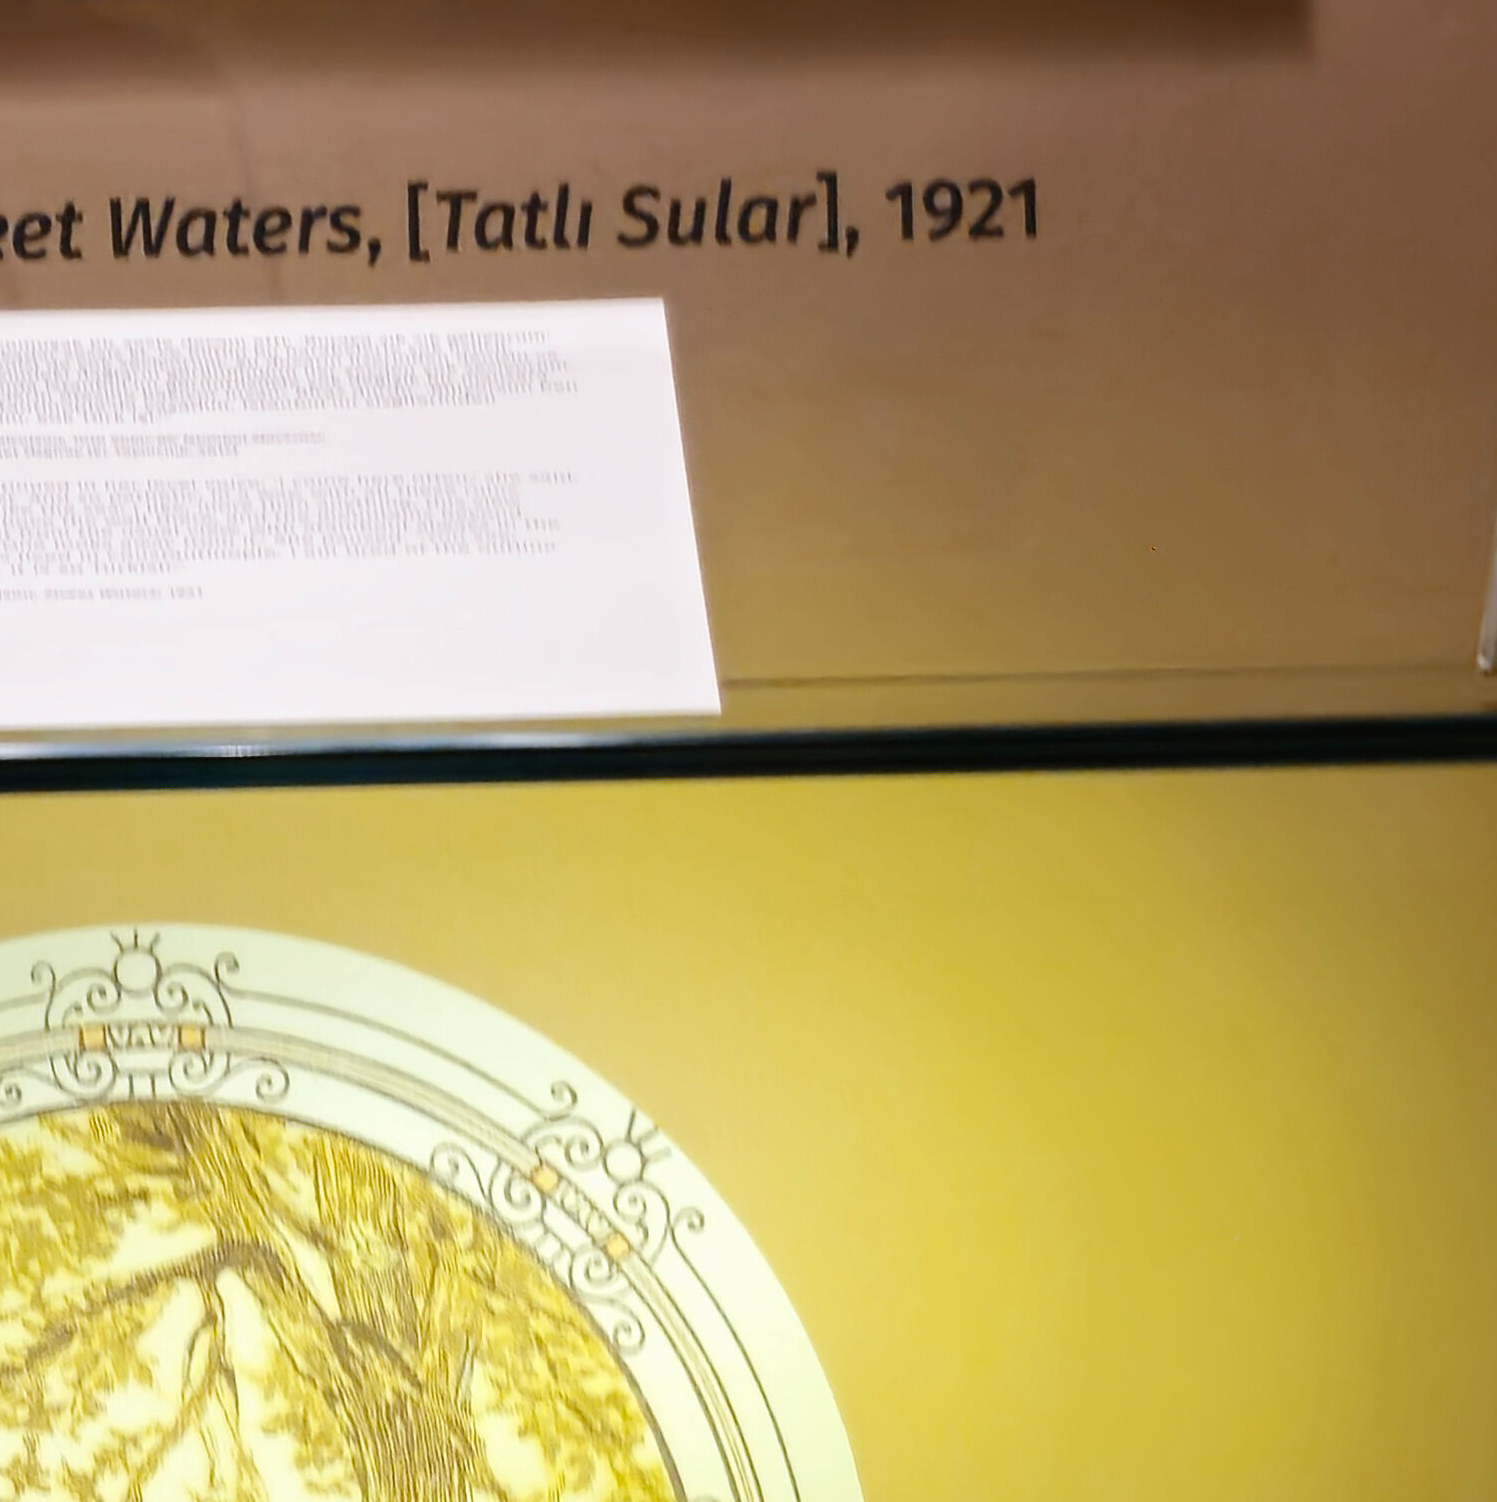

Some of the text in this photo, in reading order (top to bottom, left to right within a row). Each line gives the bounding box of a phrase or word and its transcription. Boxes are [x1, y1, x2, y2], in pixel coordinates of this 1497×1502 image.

[107, 195, 383, 269] Waters,
[405, 178, 593, 263] [Tatlı
[616, 170, 862, 258] Sular],
[884, 176, 1039, 242] 1921
